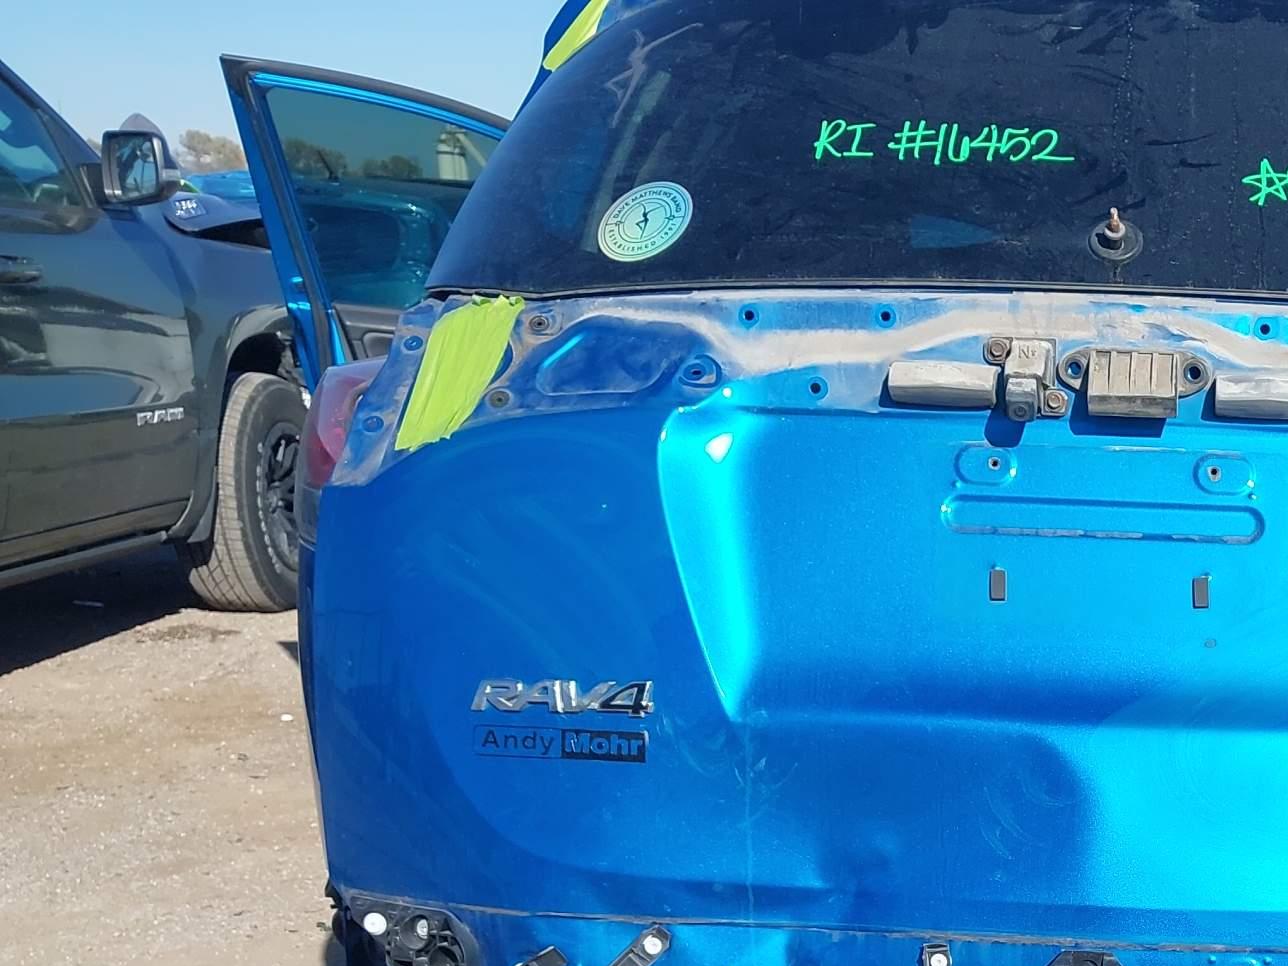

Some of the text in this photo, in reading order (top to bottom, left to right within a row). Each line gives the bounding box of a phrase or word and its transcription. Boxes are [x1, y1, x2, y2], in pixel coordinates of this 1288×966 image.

[814, 120, 1075, 165] RI #16452
[613, 202, 630, 219] DAVE
[136, 407, 184, 426] RAM
[470, 678, 655, 717] RAV4
[481, 729, 645, 757] Andy Mohr
